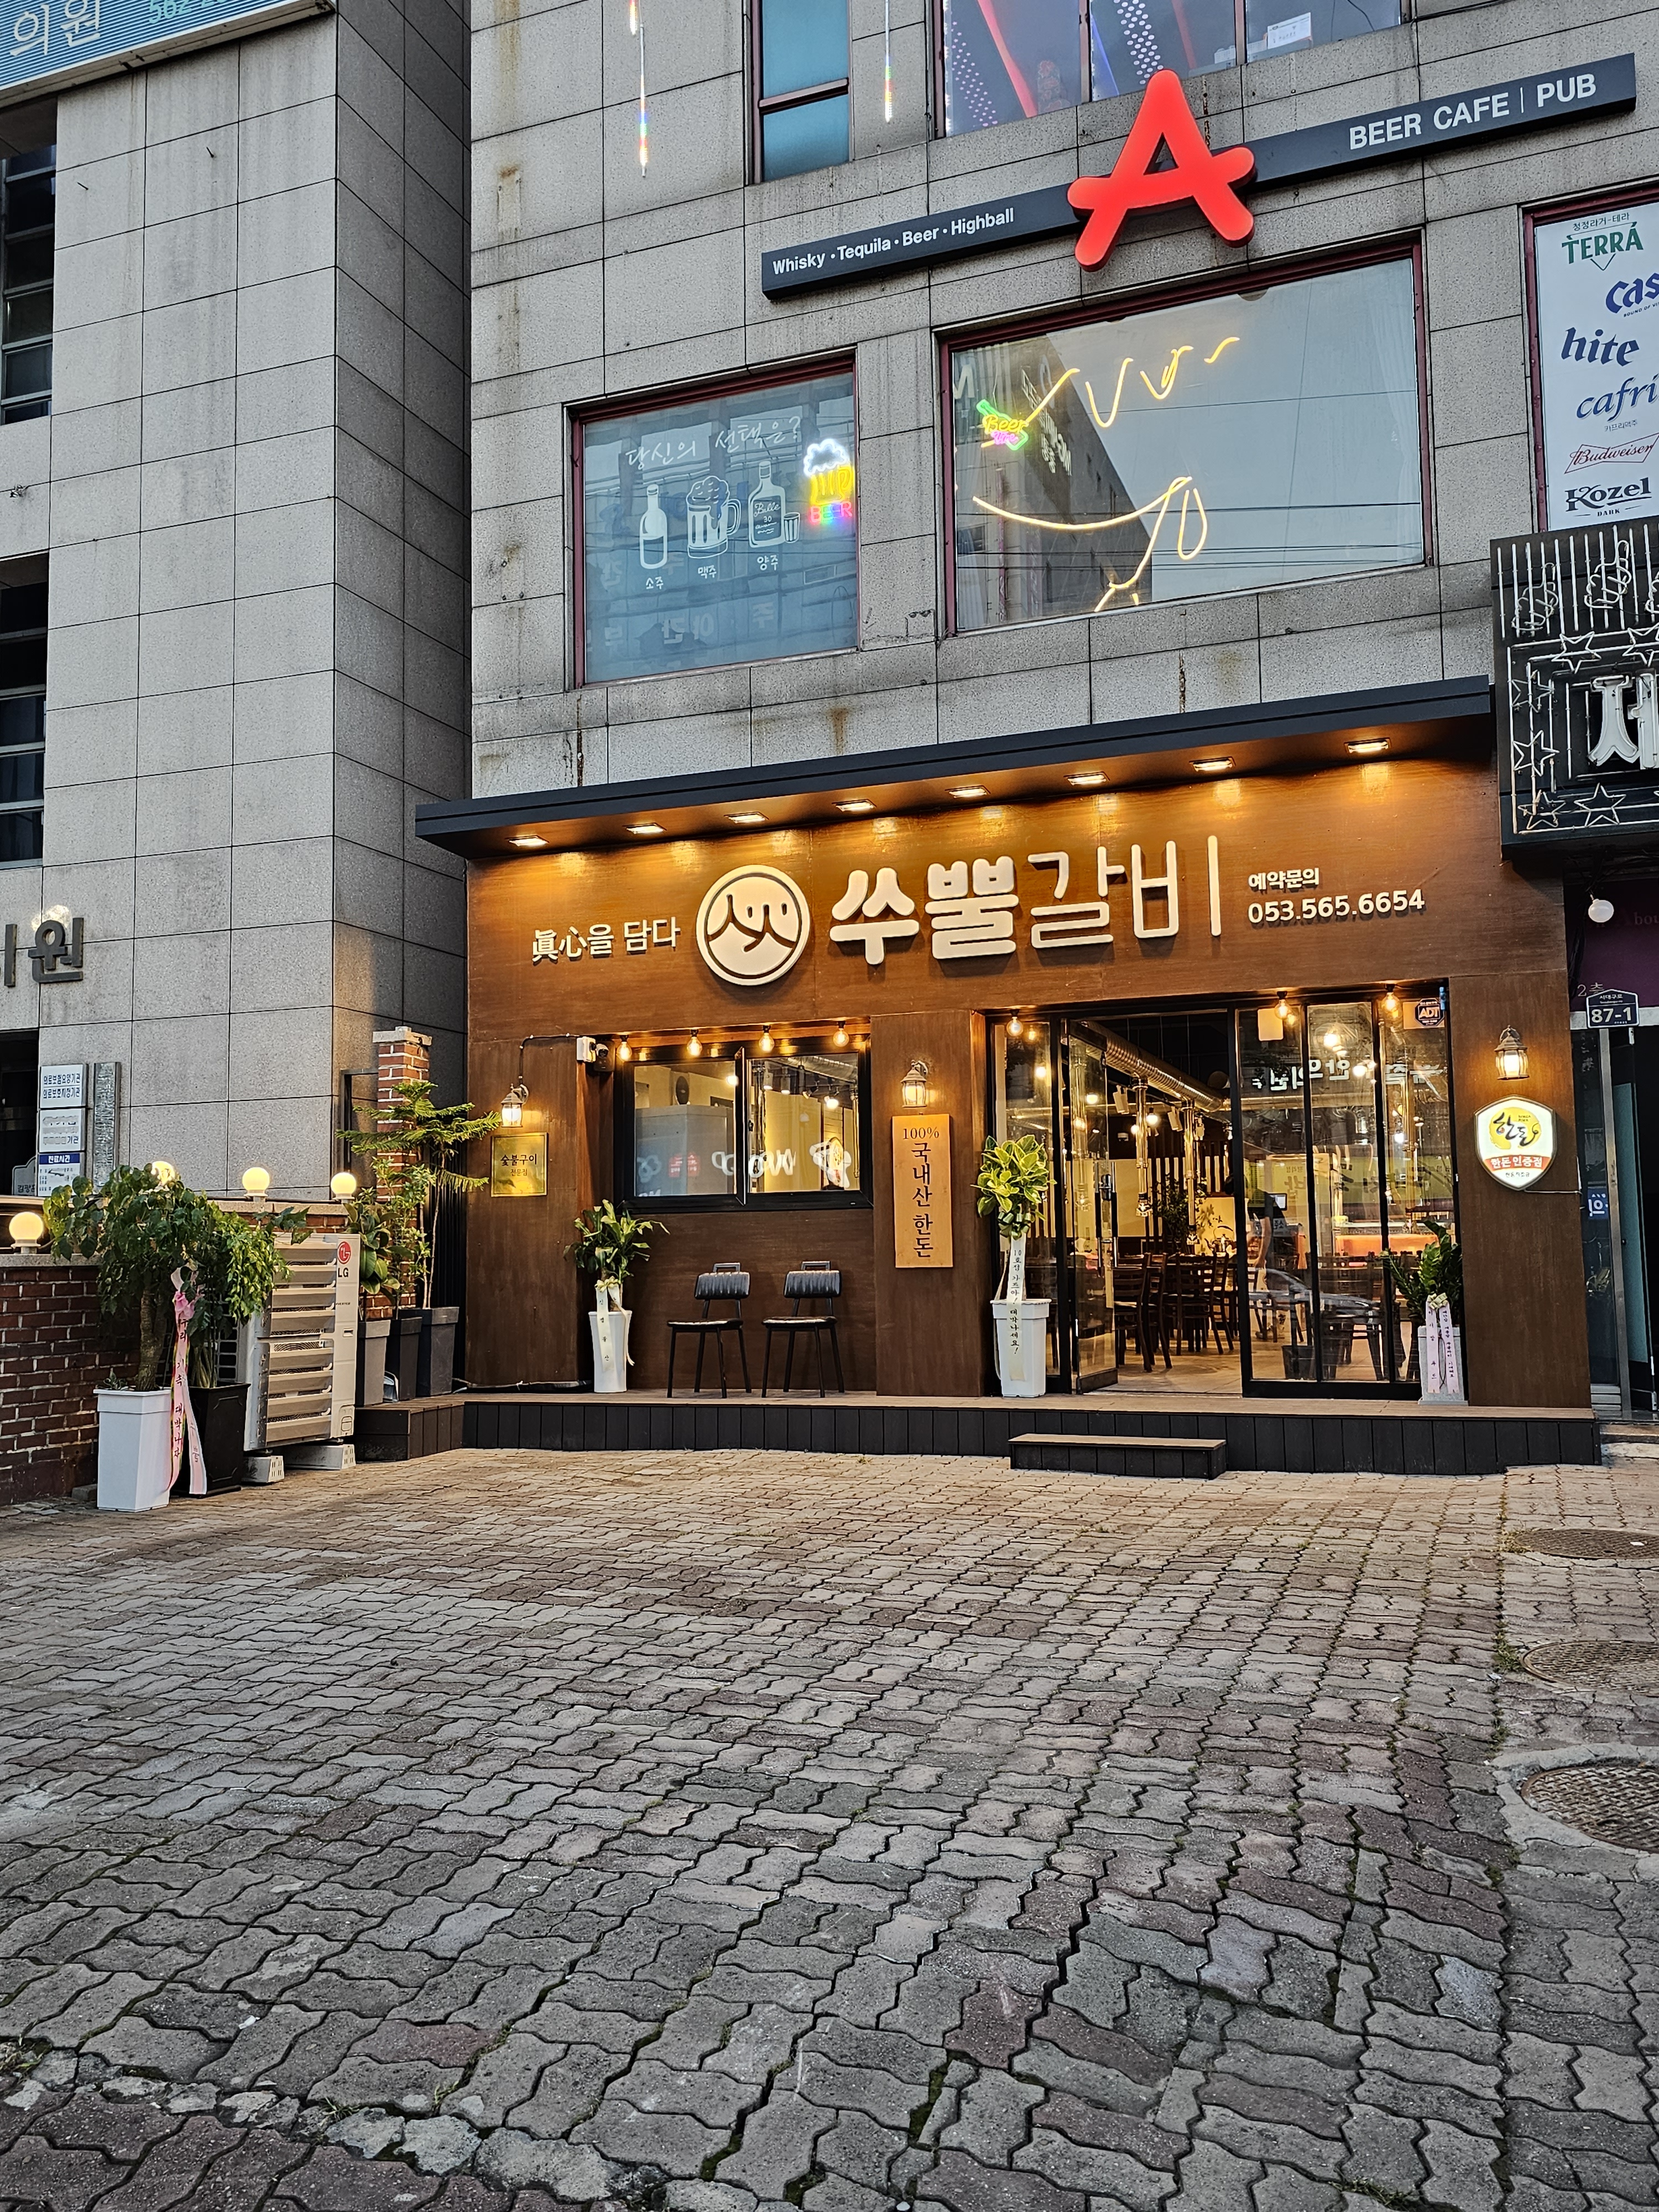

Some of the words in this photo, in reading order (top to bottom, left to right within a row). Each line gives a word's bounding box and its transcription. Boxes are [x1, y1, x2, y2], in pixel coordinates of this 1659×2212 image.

[1349, 113, 1421, 150] BEER
[1433, 92, 1510, 130] CAFE
[1537, 74, 1597, 107] PUB
[773, 252, 826, 275] Whisky
[837, 237, 891, 260] Tequila
[902, 227, 939, 247] Beer
[951, 207, 1014, 236] Highball
[1561, 327, 1640, 366] hite
[982, 414, 1029, 435] Beer
[625, 441, 695, 470] 당신의
[716, 416, 801, 453] 선택은?
[1570, 444, 1653, 465] Budweiser
[1564, 477, 1651, 512] Kozel
[811, 500, 852, 523] BEER
[1597, 508, 1620, 517] DARK
[698, 565, 717, 579] 맥주
[757, 555, 778, 571] 양주
[646, 576, 664, 589] 소주
[1248, 868, 1319, 890] 예약문의
[1248, 889, 1425, 923] 053.565.6654
[624, 916, 681, 952] 담다
[1418, 1007, 1439, 1018] ADT
[1592, 1007, 1631, 1023] 87-1
[902, 1126, 939, 1139] 100%
[500, 1154, 536, 1166] 숯불구이
[911, 1142, 933, 1207] 국내산
[912, 1214, 933, 1258] 한돈
[338, 1267, 348, 1277] LG
[1010, 1308, 1019, 1354] 대박나세요!
